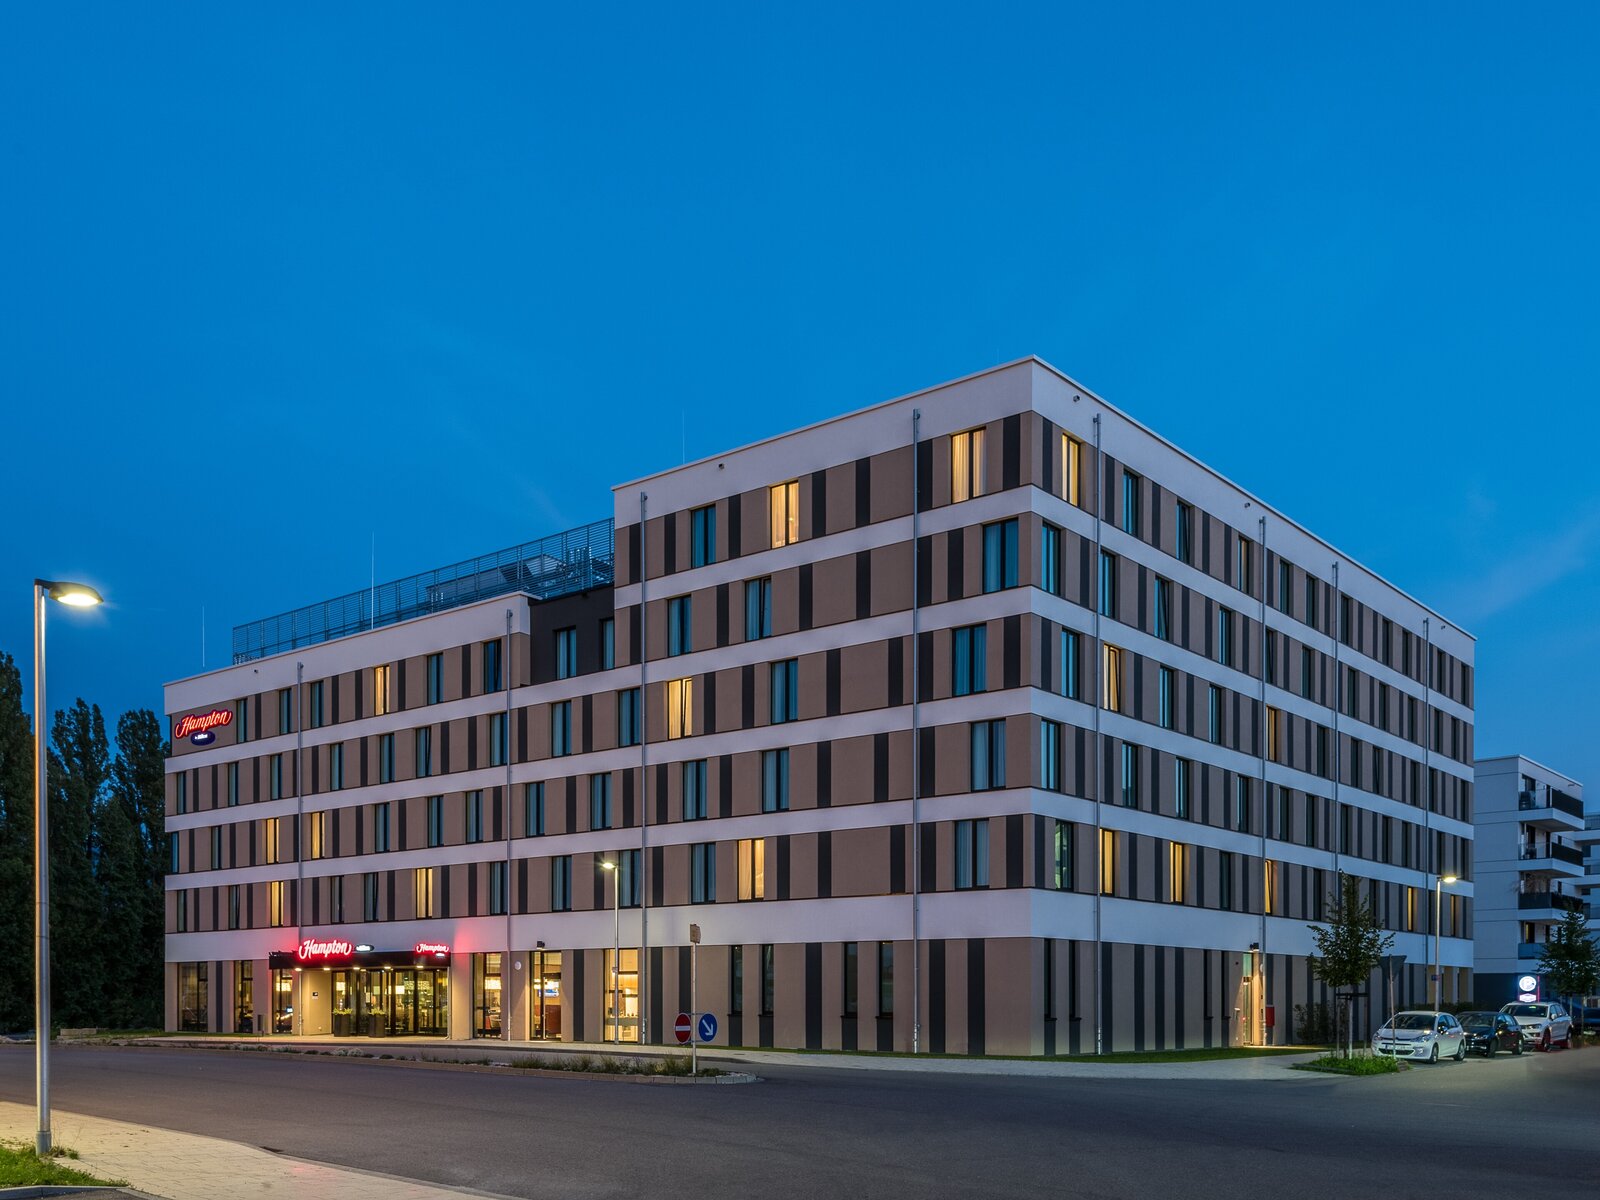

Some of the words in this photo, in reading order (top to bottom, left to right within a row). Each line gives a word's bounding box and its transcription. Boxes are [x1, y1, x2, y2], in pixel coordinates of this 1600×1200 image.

[175, 710, 232, 738] Hampton
[298, 939, 352, 959] Hampton
[416, 943, 450, 954] Hampton
